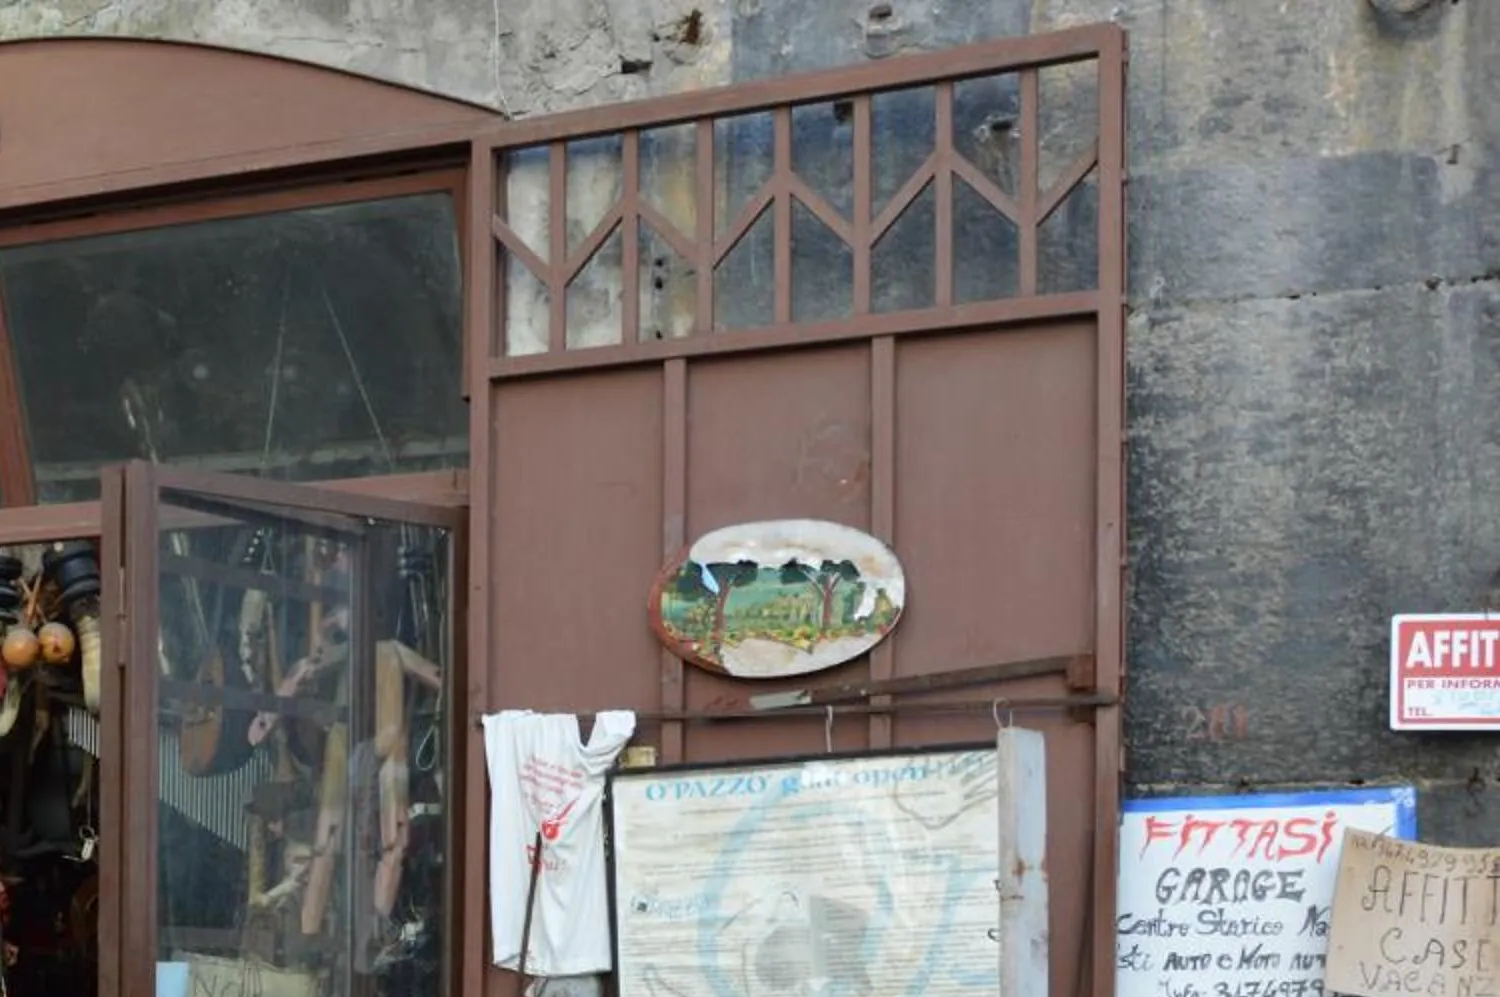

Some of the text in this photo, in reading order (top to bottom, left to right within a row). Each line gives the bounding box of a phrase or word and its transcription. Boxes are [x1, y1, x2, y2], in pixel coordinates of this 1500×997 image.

[1405, 629, 1500, 669] AFFIT
[1406, 678, 1437, 690] PER
[1155, 867, 1307, 905] GARAGE
[1360, 864, 1500, 926] AFFITT
[1359, 960, 1499, 997] VACANZ
